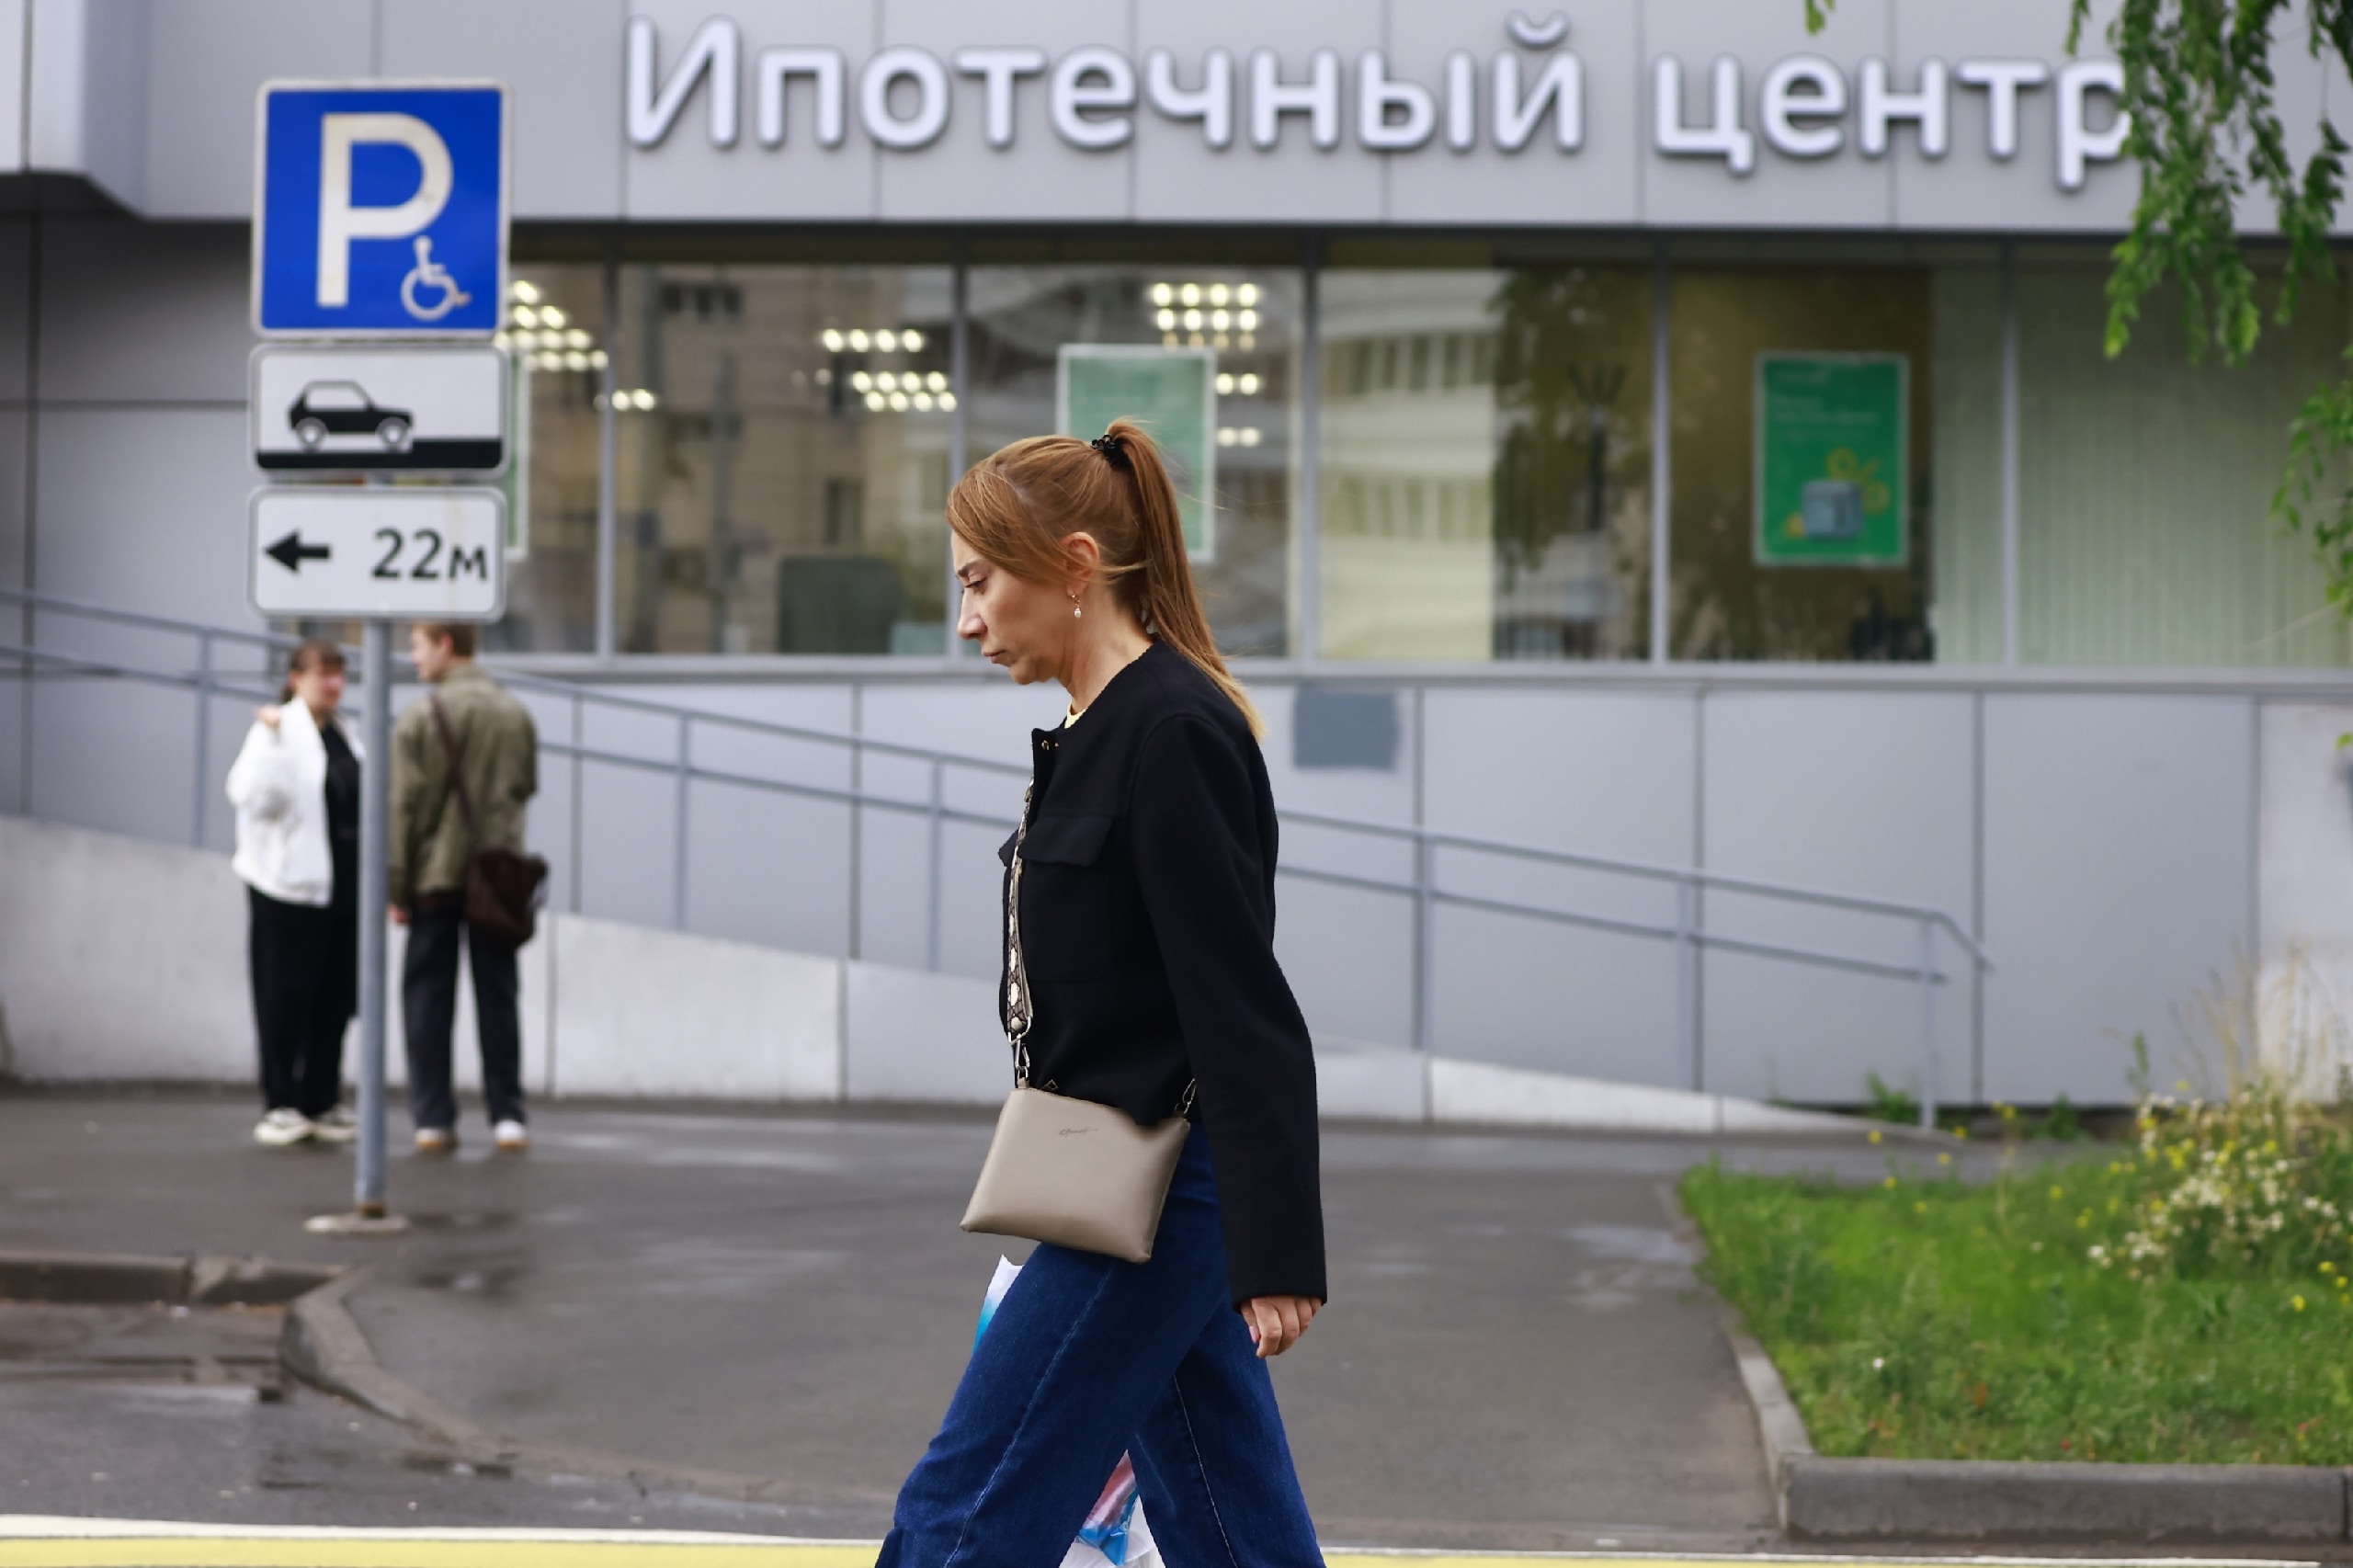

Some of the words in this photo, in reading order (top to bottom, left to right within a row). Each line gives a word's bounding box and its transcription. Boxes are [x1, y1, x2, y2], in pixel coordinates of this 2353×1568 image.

[626, 11, 1584, 150] Ипотечный
[1653, 55, 2133, 188] центр
[317, 112, 454, 308] P
